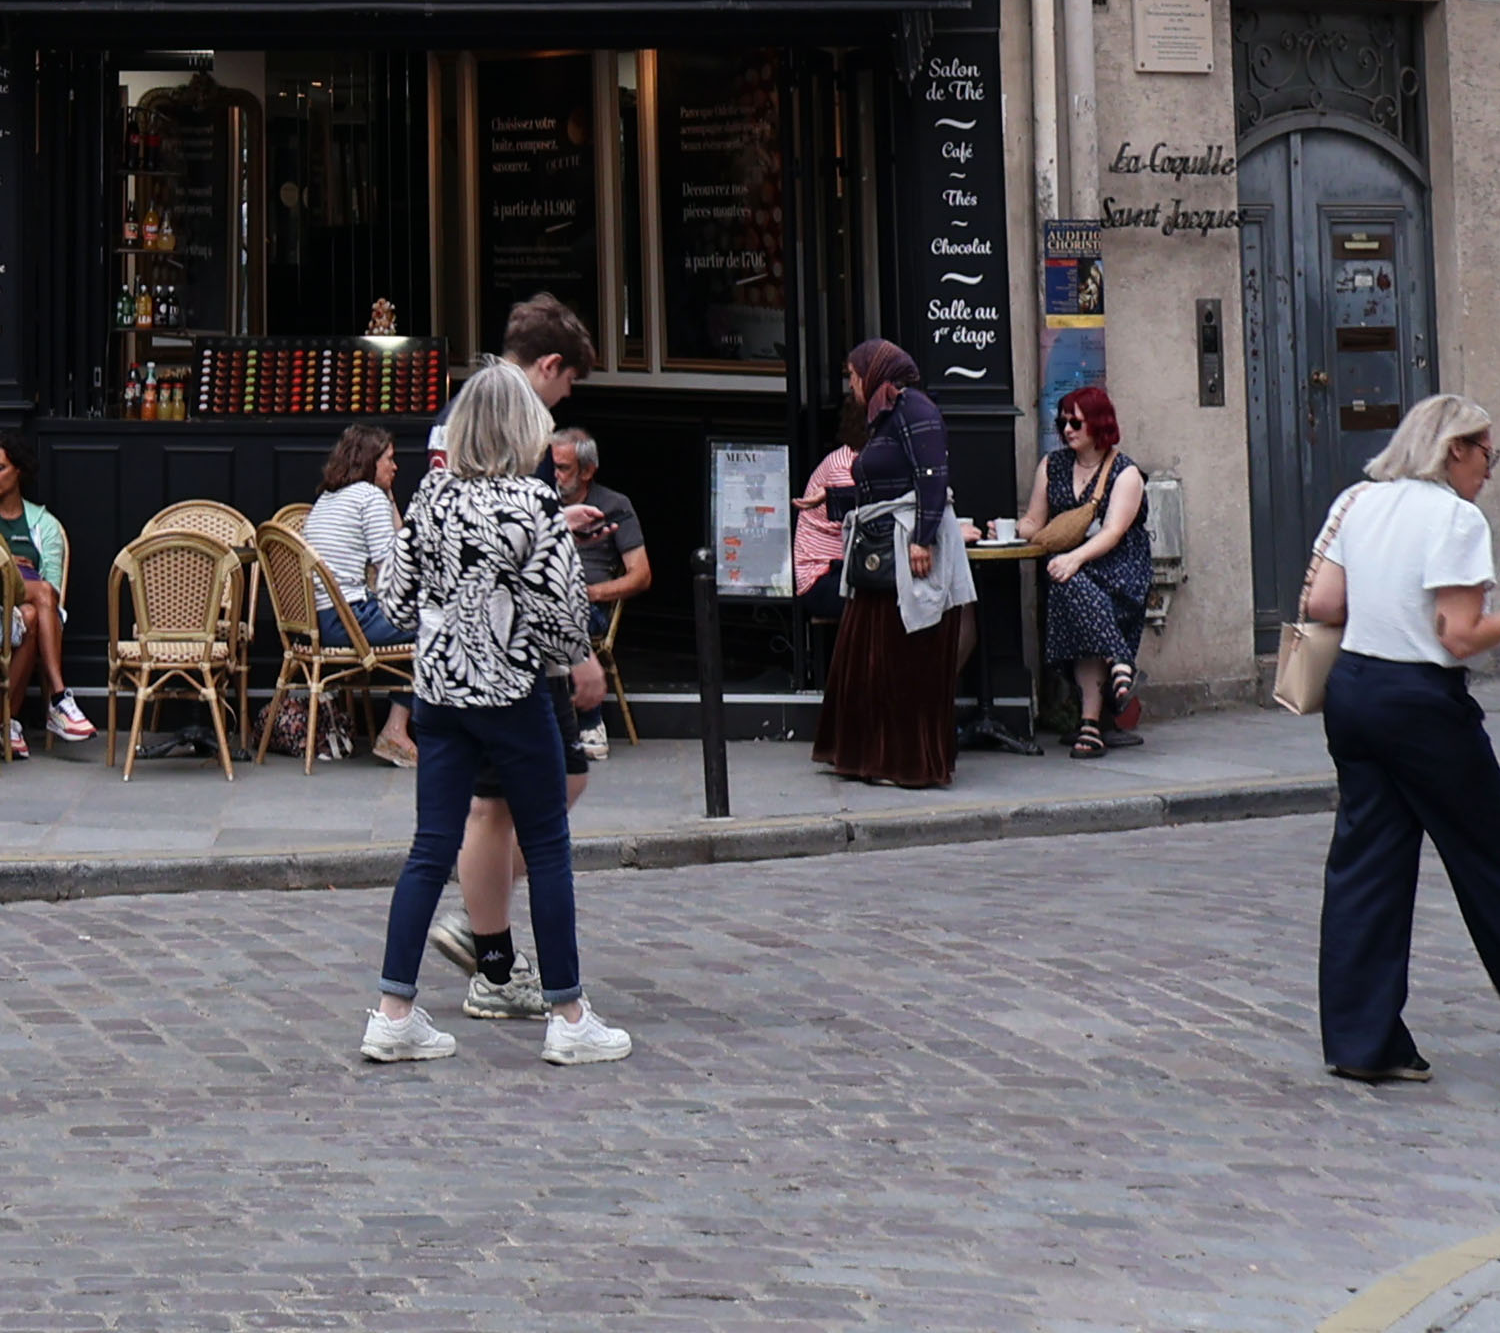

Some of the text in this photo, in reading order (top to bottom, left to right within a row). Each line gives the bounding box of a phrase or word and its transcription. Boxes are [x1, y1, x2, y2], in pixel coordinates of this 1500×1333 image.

[928, 58, 980, 77] Salon
[926, 80, 985, 101] de Thé
[942, 142, 973, 162] Café
[1108, 142, 1237, 182] La Coquille
[943, 189, 978, 206] Thés
[1100, 197, 1248, 237] Saint Jacques
[931, 238, 992, 255] Chocolat
[928, 299, 999, 320] Salle au
[932, 325, 996, 349] 1er étage
